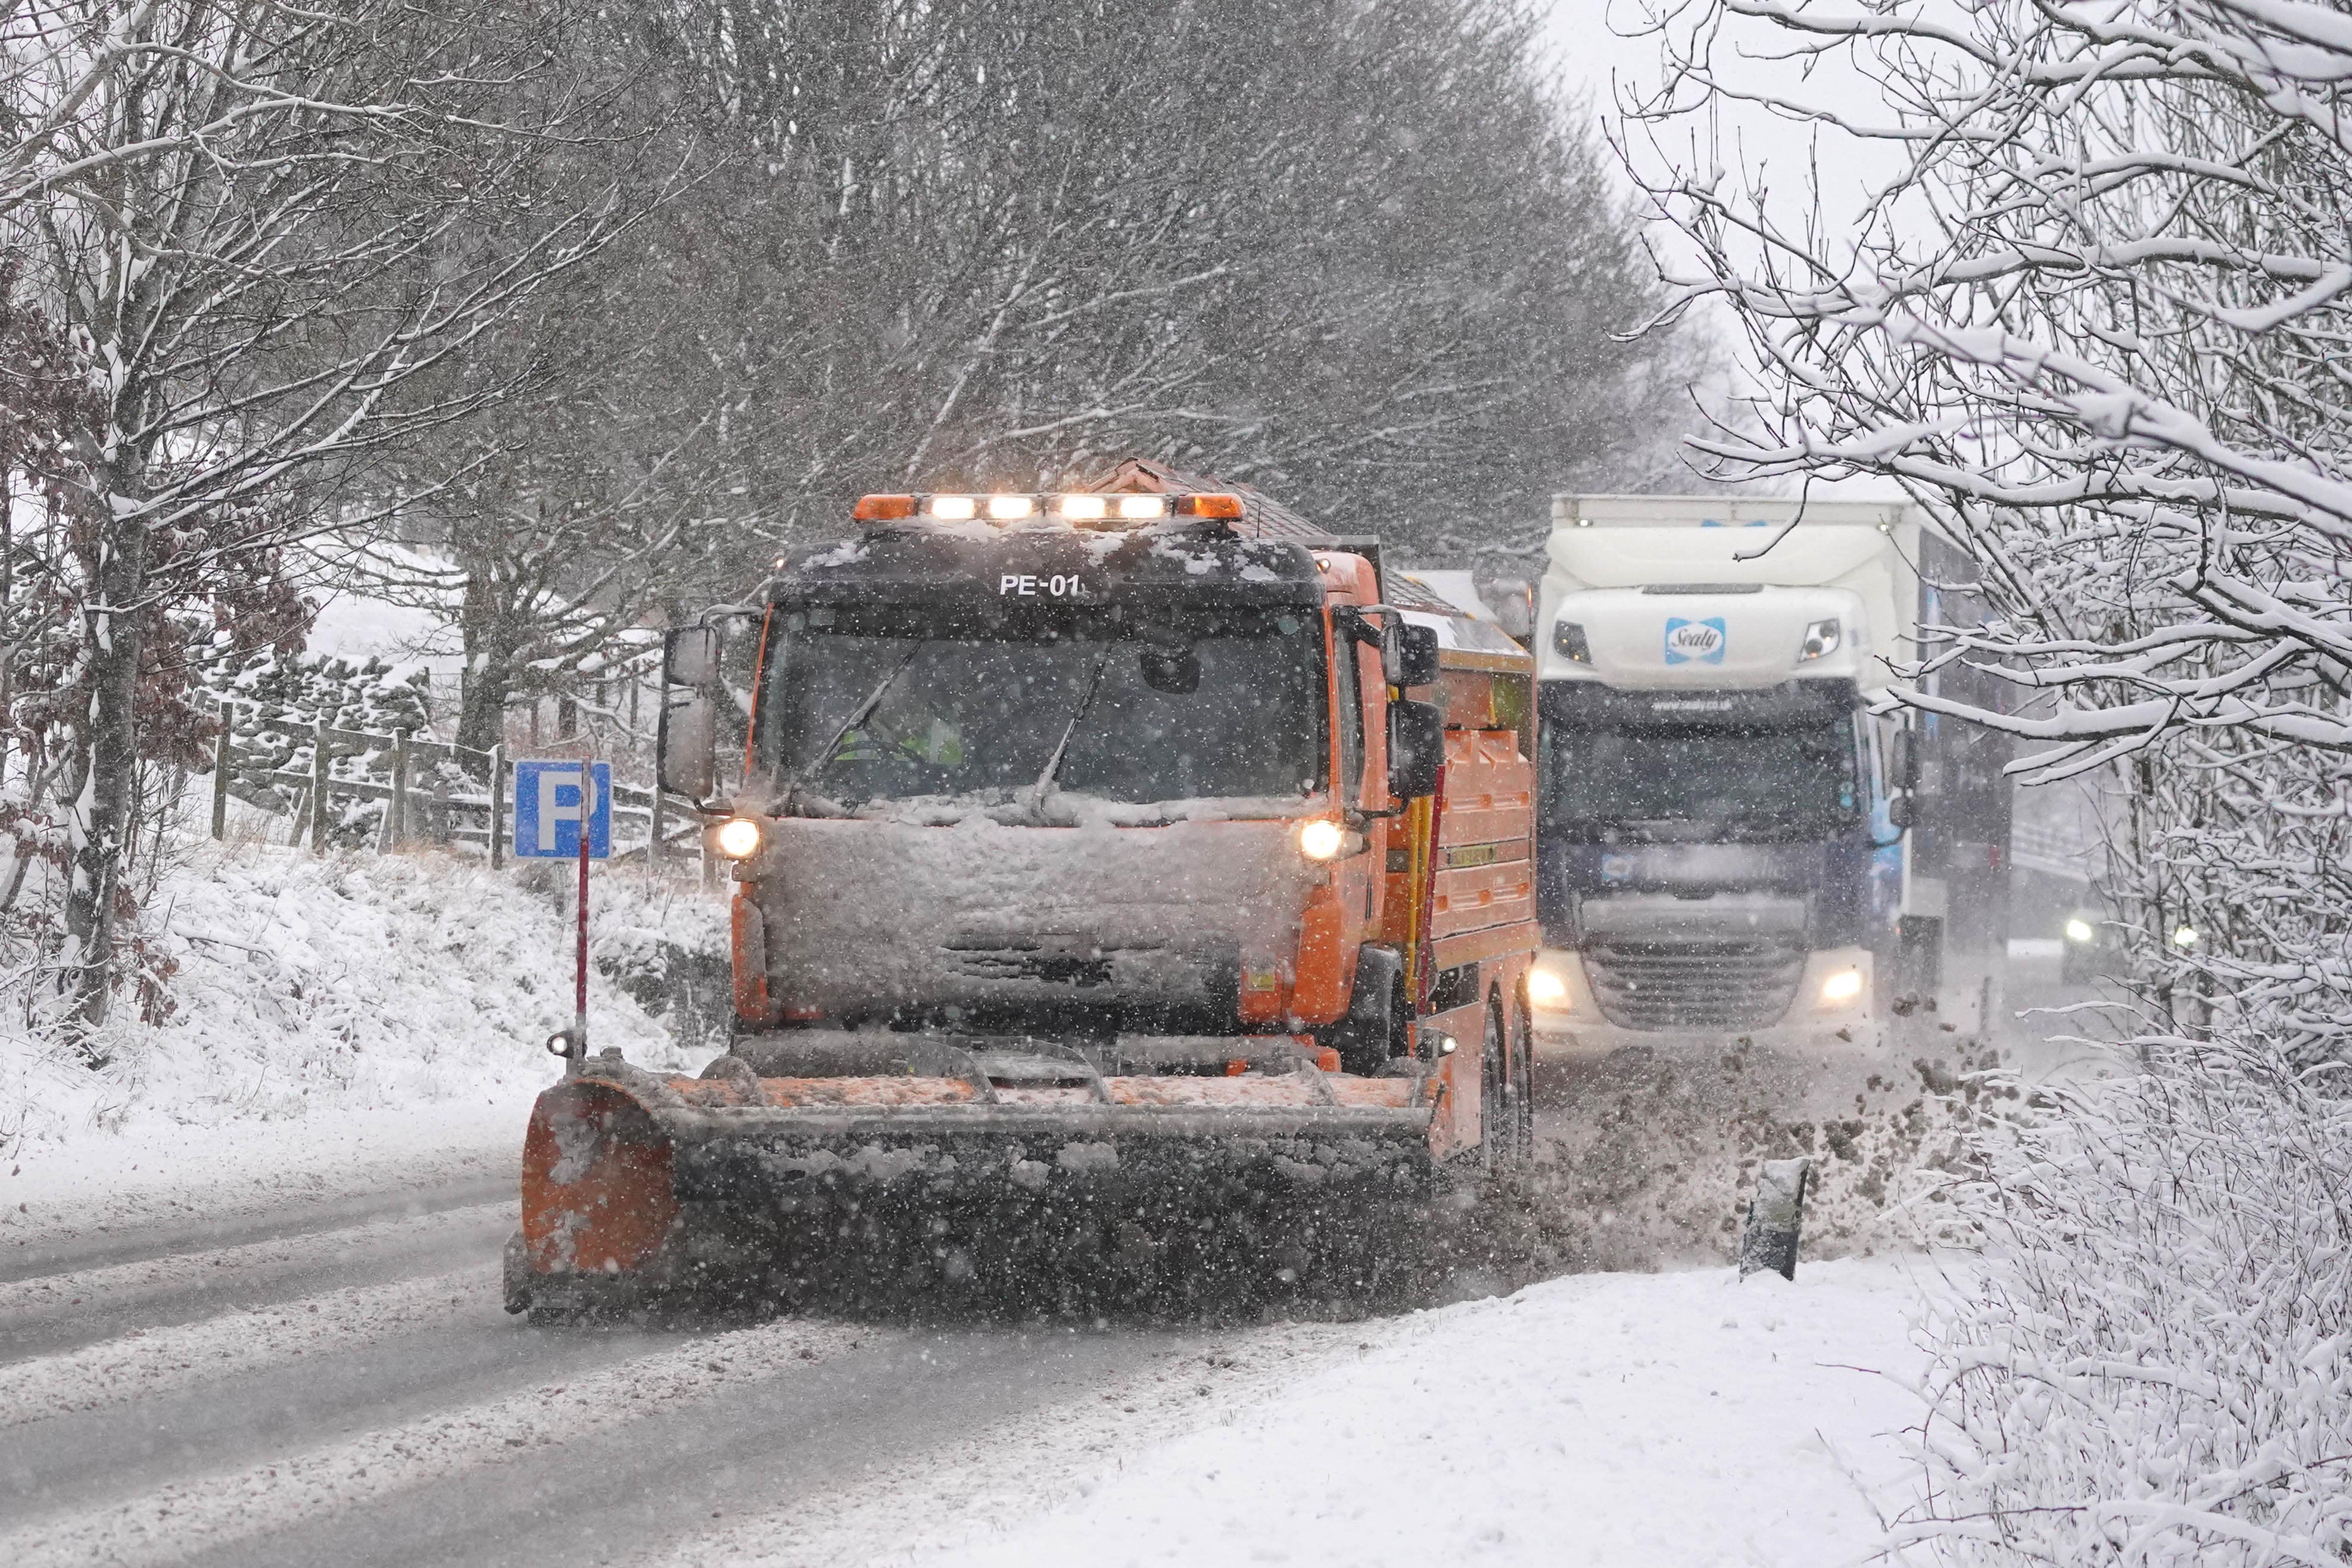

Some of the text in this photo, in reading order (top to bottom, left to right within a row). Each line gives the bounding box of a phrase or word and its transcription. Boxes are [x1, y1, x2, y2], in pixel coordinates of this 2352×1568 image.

[1000, 575, 1080, 597] PE-01
[1671, 628, 1718, 651] Sealy
[538, 771, 598, 850] P
